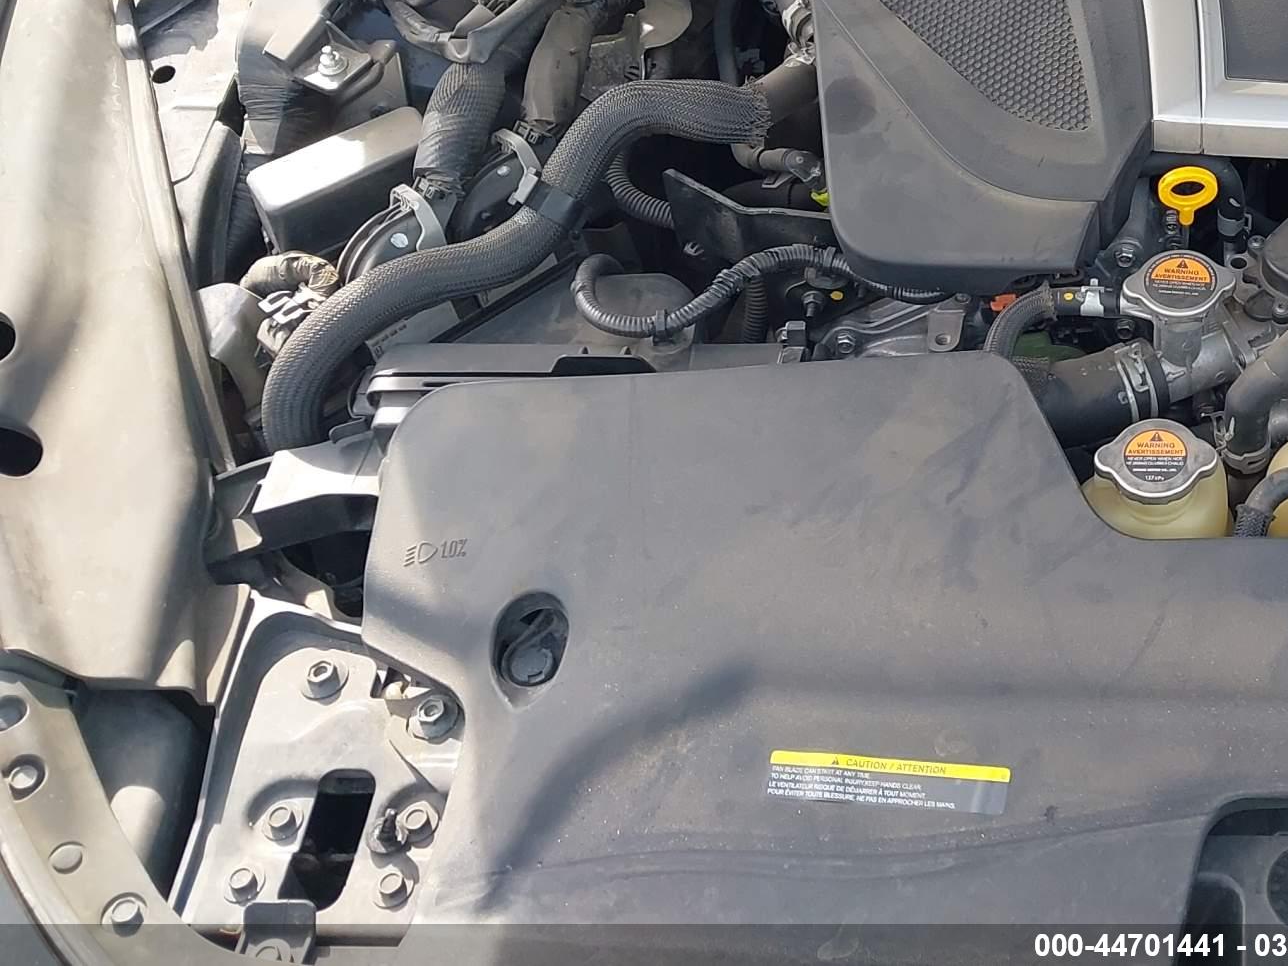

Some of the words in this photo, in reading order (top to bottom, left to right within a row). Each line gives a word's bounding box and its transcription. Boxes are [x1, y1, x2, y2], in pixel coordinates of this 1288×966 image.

[846, 759, 887, 770] CAUTION
[896, 763, 947, 774] ATTENTION
[813, 775, 843, 784] PERSONAL
[880, 781, 901, 789] HANDS
[887, 797, 923, 806] APPROCHER
